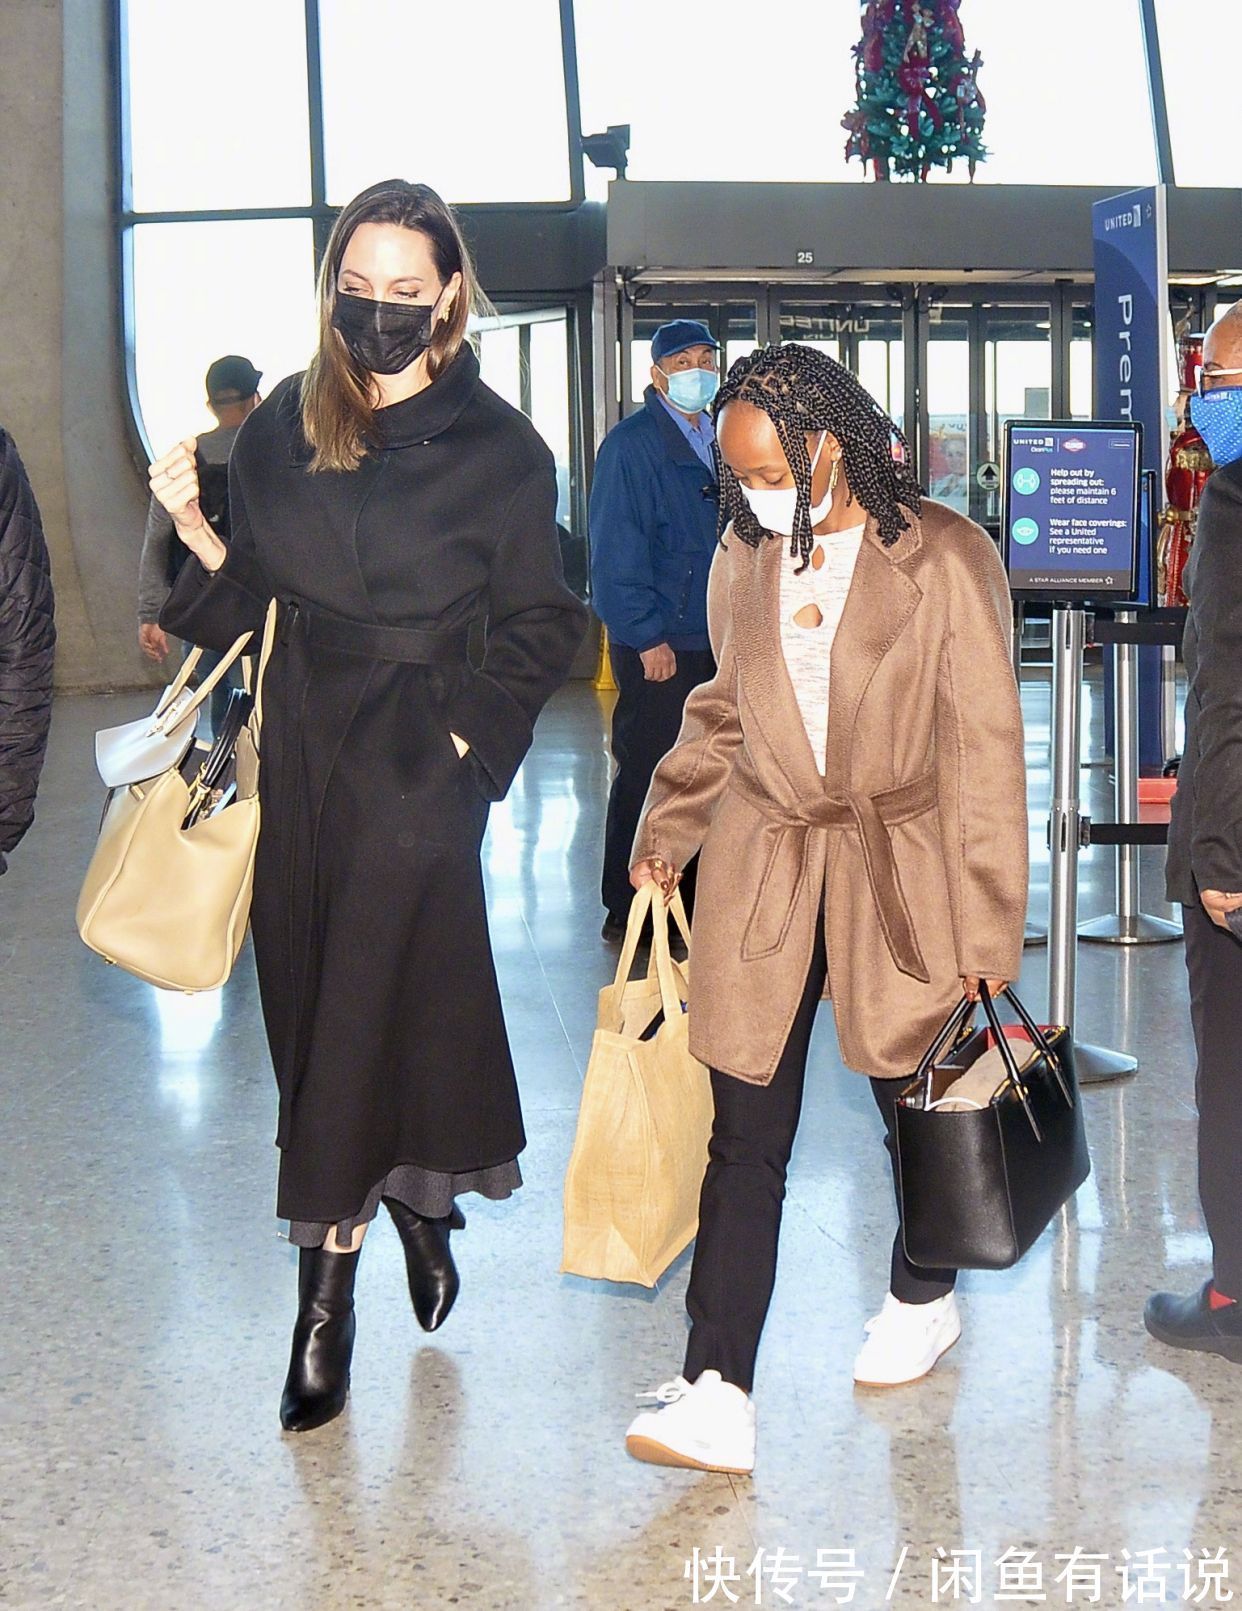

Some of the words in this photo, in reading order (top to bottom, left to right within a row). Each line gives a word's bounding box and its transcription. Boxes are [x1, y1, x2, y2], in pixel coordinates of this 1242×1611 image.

[1104, 212, 1133, 231] UNITED
[797, 252, 813, 264] 25
[1050, 469, 1068, 477] Help
[1070, 469, 1083, 477] out
[1084, 469, 1095, 478] by
[1050, 478, 1088, 487] spreading
[1050, 487, 1075, 496] please
[1076, 487, 1110, 495] maintain
[1111, 487, 1117, 496] 6
[1050, 496, 1065, 504] feet
[1066, 496, 1076, 504] of
[1077, 497, 1108, 505] distance
[1071, 518, 1088, 526] face
[1088, 519, 1127, 528] coverings:
[1049, 528, 1063, 536] See
[1071, 528, 1097, 536] United
[1049, 537, 1104, 546] representative
[1049, 546, 1056, 554] if
[1056, 547, 1071, 555] you
[1072, 546, 1092, 554] need
[1093, 547, 1108, 555] one
